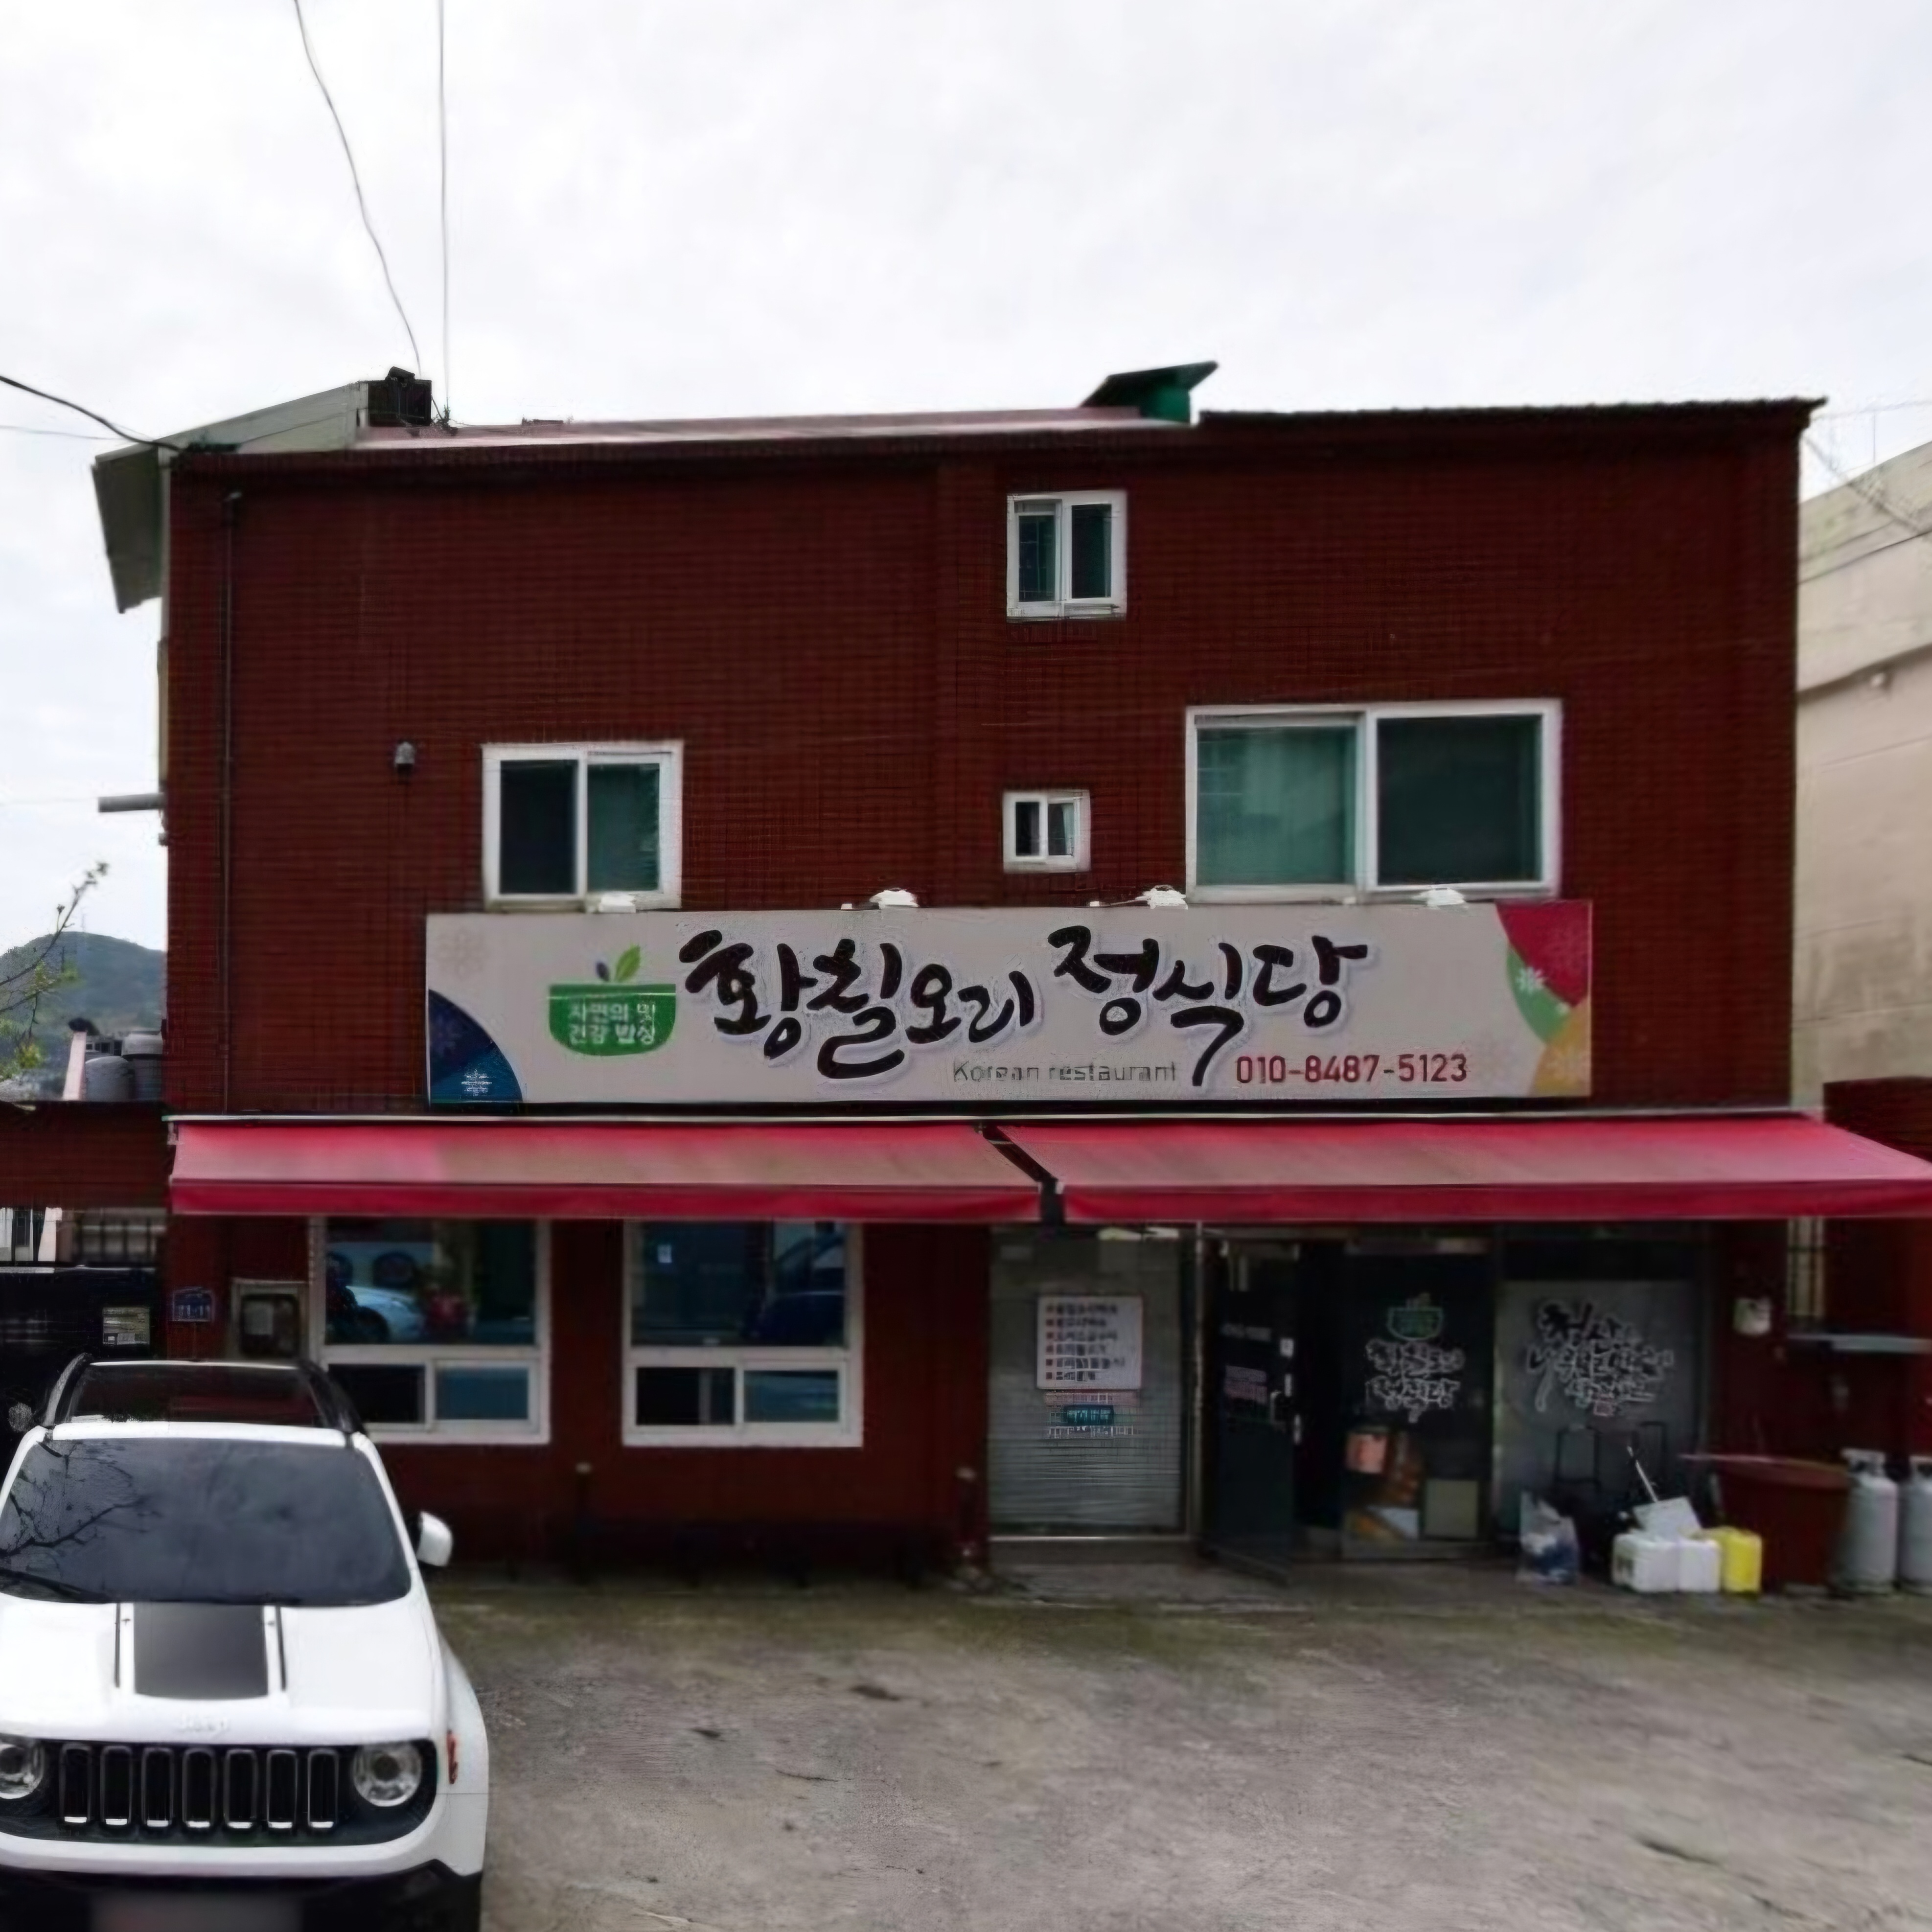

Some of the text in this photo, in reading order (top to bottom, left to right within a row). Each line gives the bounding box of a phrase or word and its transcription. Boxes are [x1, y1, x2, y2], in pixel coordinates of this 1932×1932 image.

[679, 926, 1368, 1086] 황칠오리 정식당
[953, 1060, 1176, 1082] Korean restaurant
[1236, 1054, 1468, 1084] 010-8487-5123
